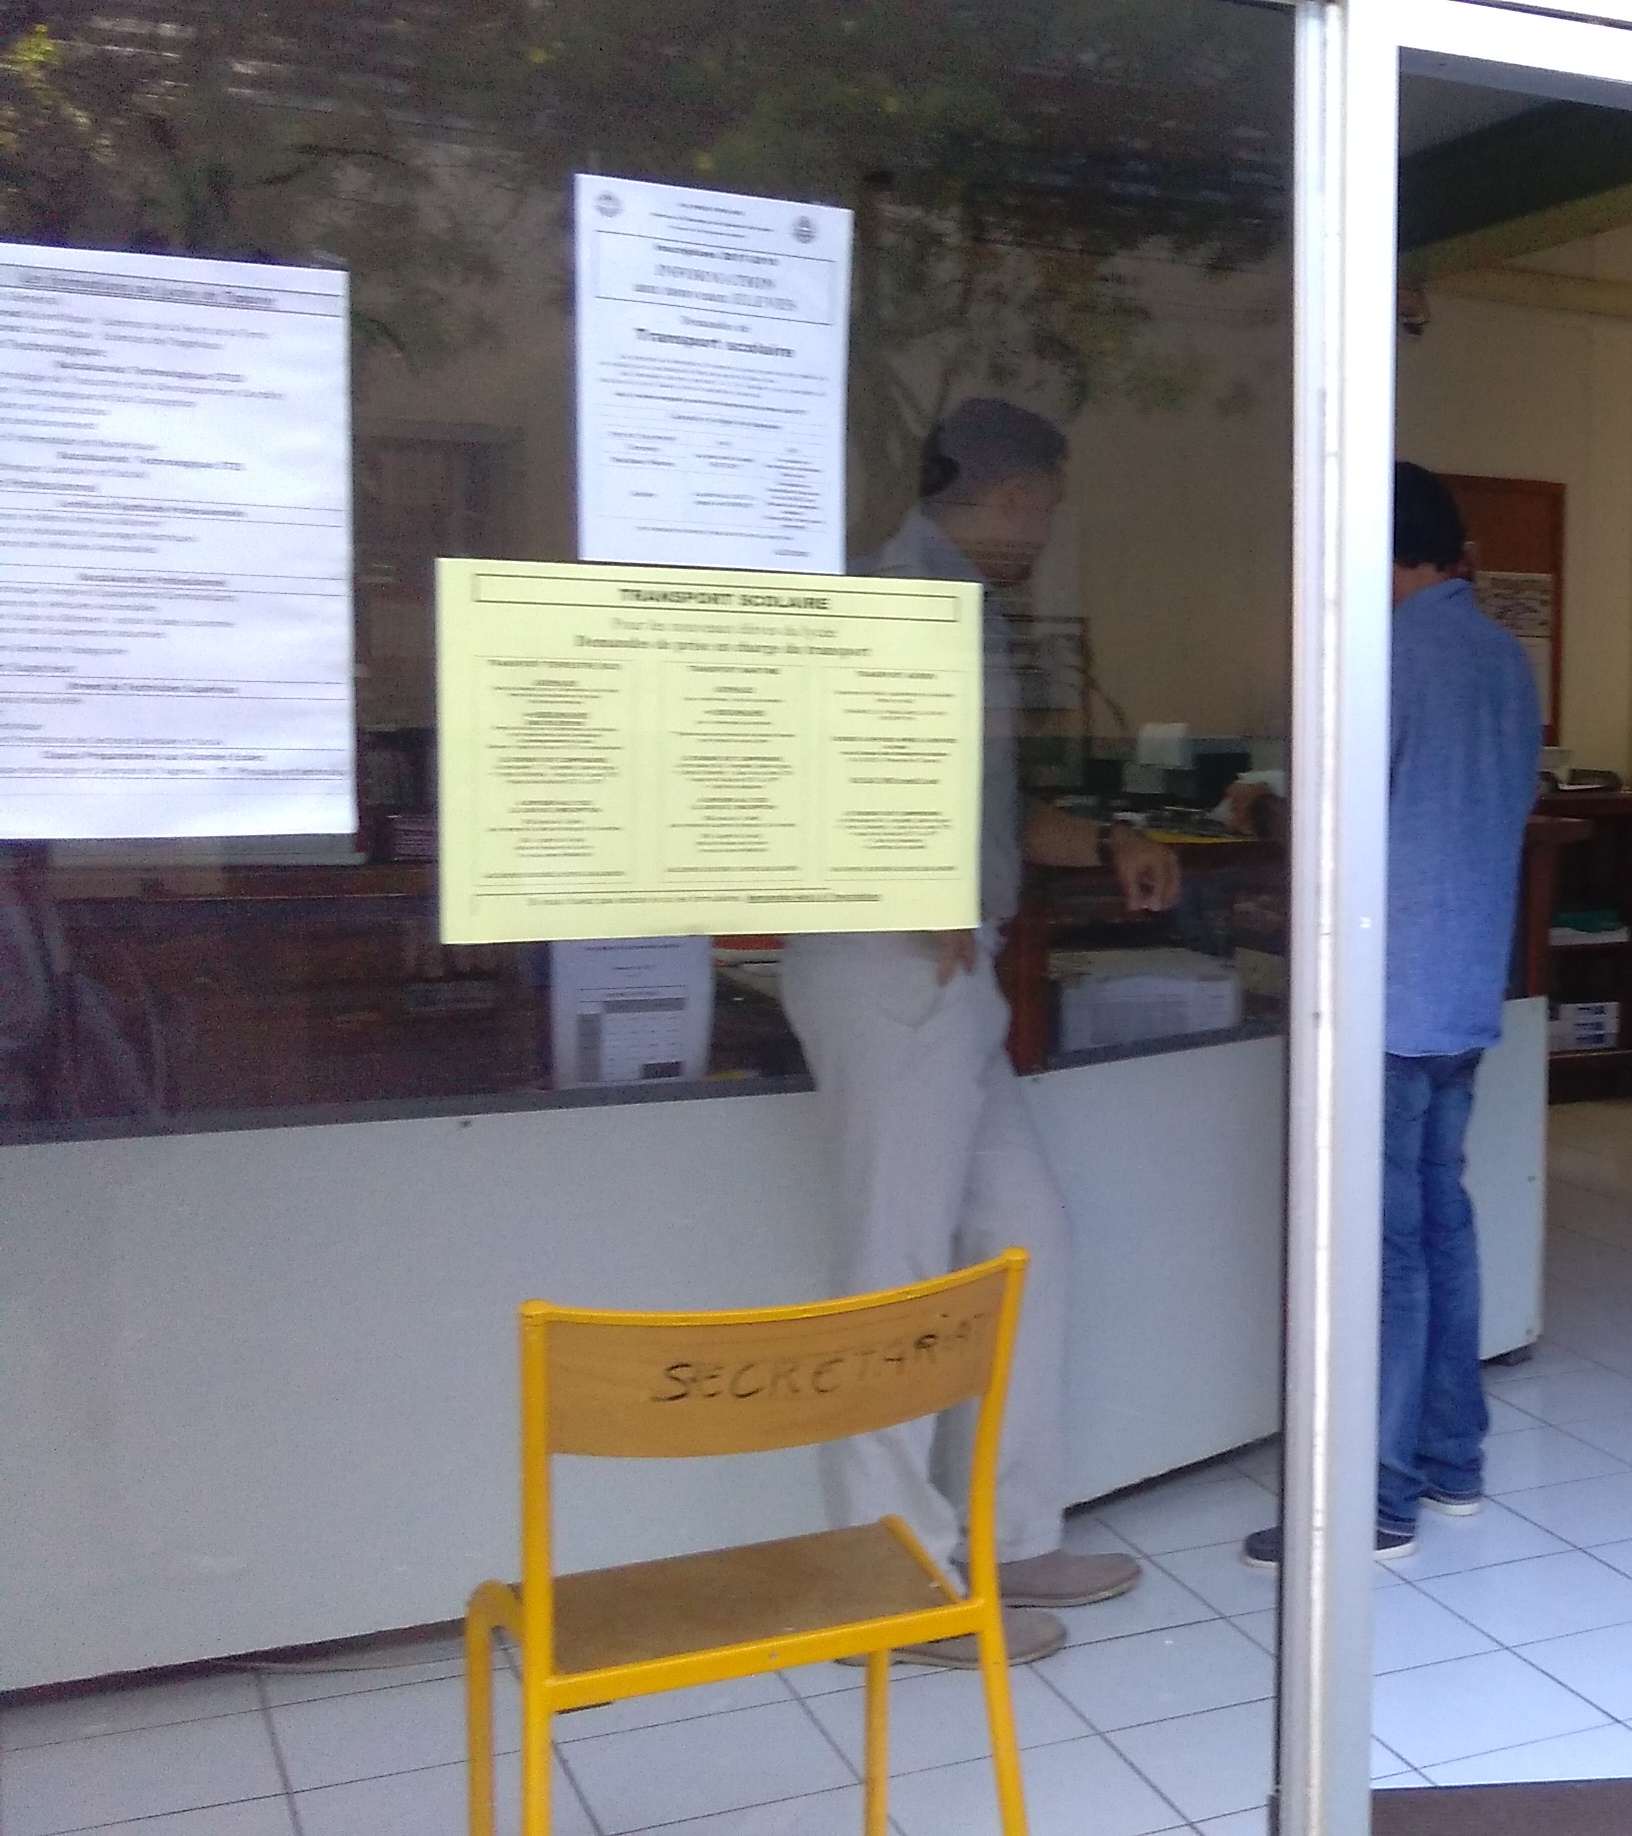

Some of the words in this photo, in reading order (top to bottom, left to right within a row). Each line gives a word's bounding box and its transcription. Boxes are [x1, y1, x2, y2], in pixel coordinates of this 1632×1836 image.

[634, 327, 721, 349] Transport
[726, 341, 796, 359] scolaire
[619, 587, 733, 605] TRANSPORT
[738, 593, 831, 611] SCOLAIRE
[611, 616, 646, 631] Pour
[677, 639, 710, 654] prise
[738, 641, 780, 655] charge
[808, 645, 872, 659] transport
[650, 1311, 985, 1402] SECRETAR
